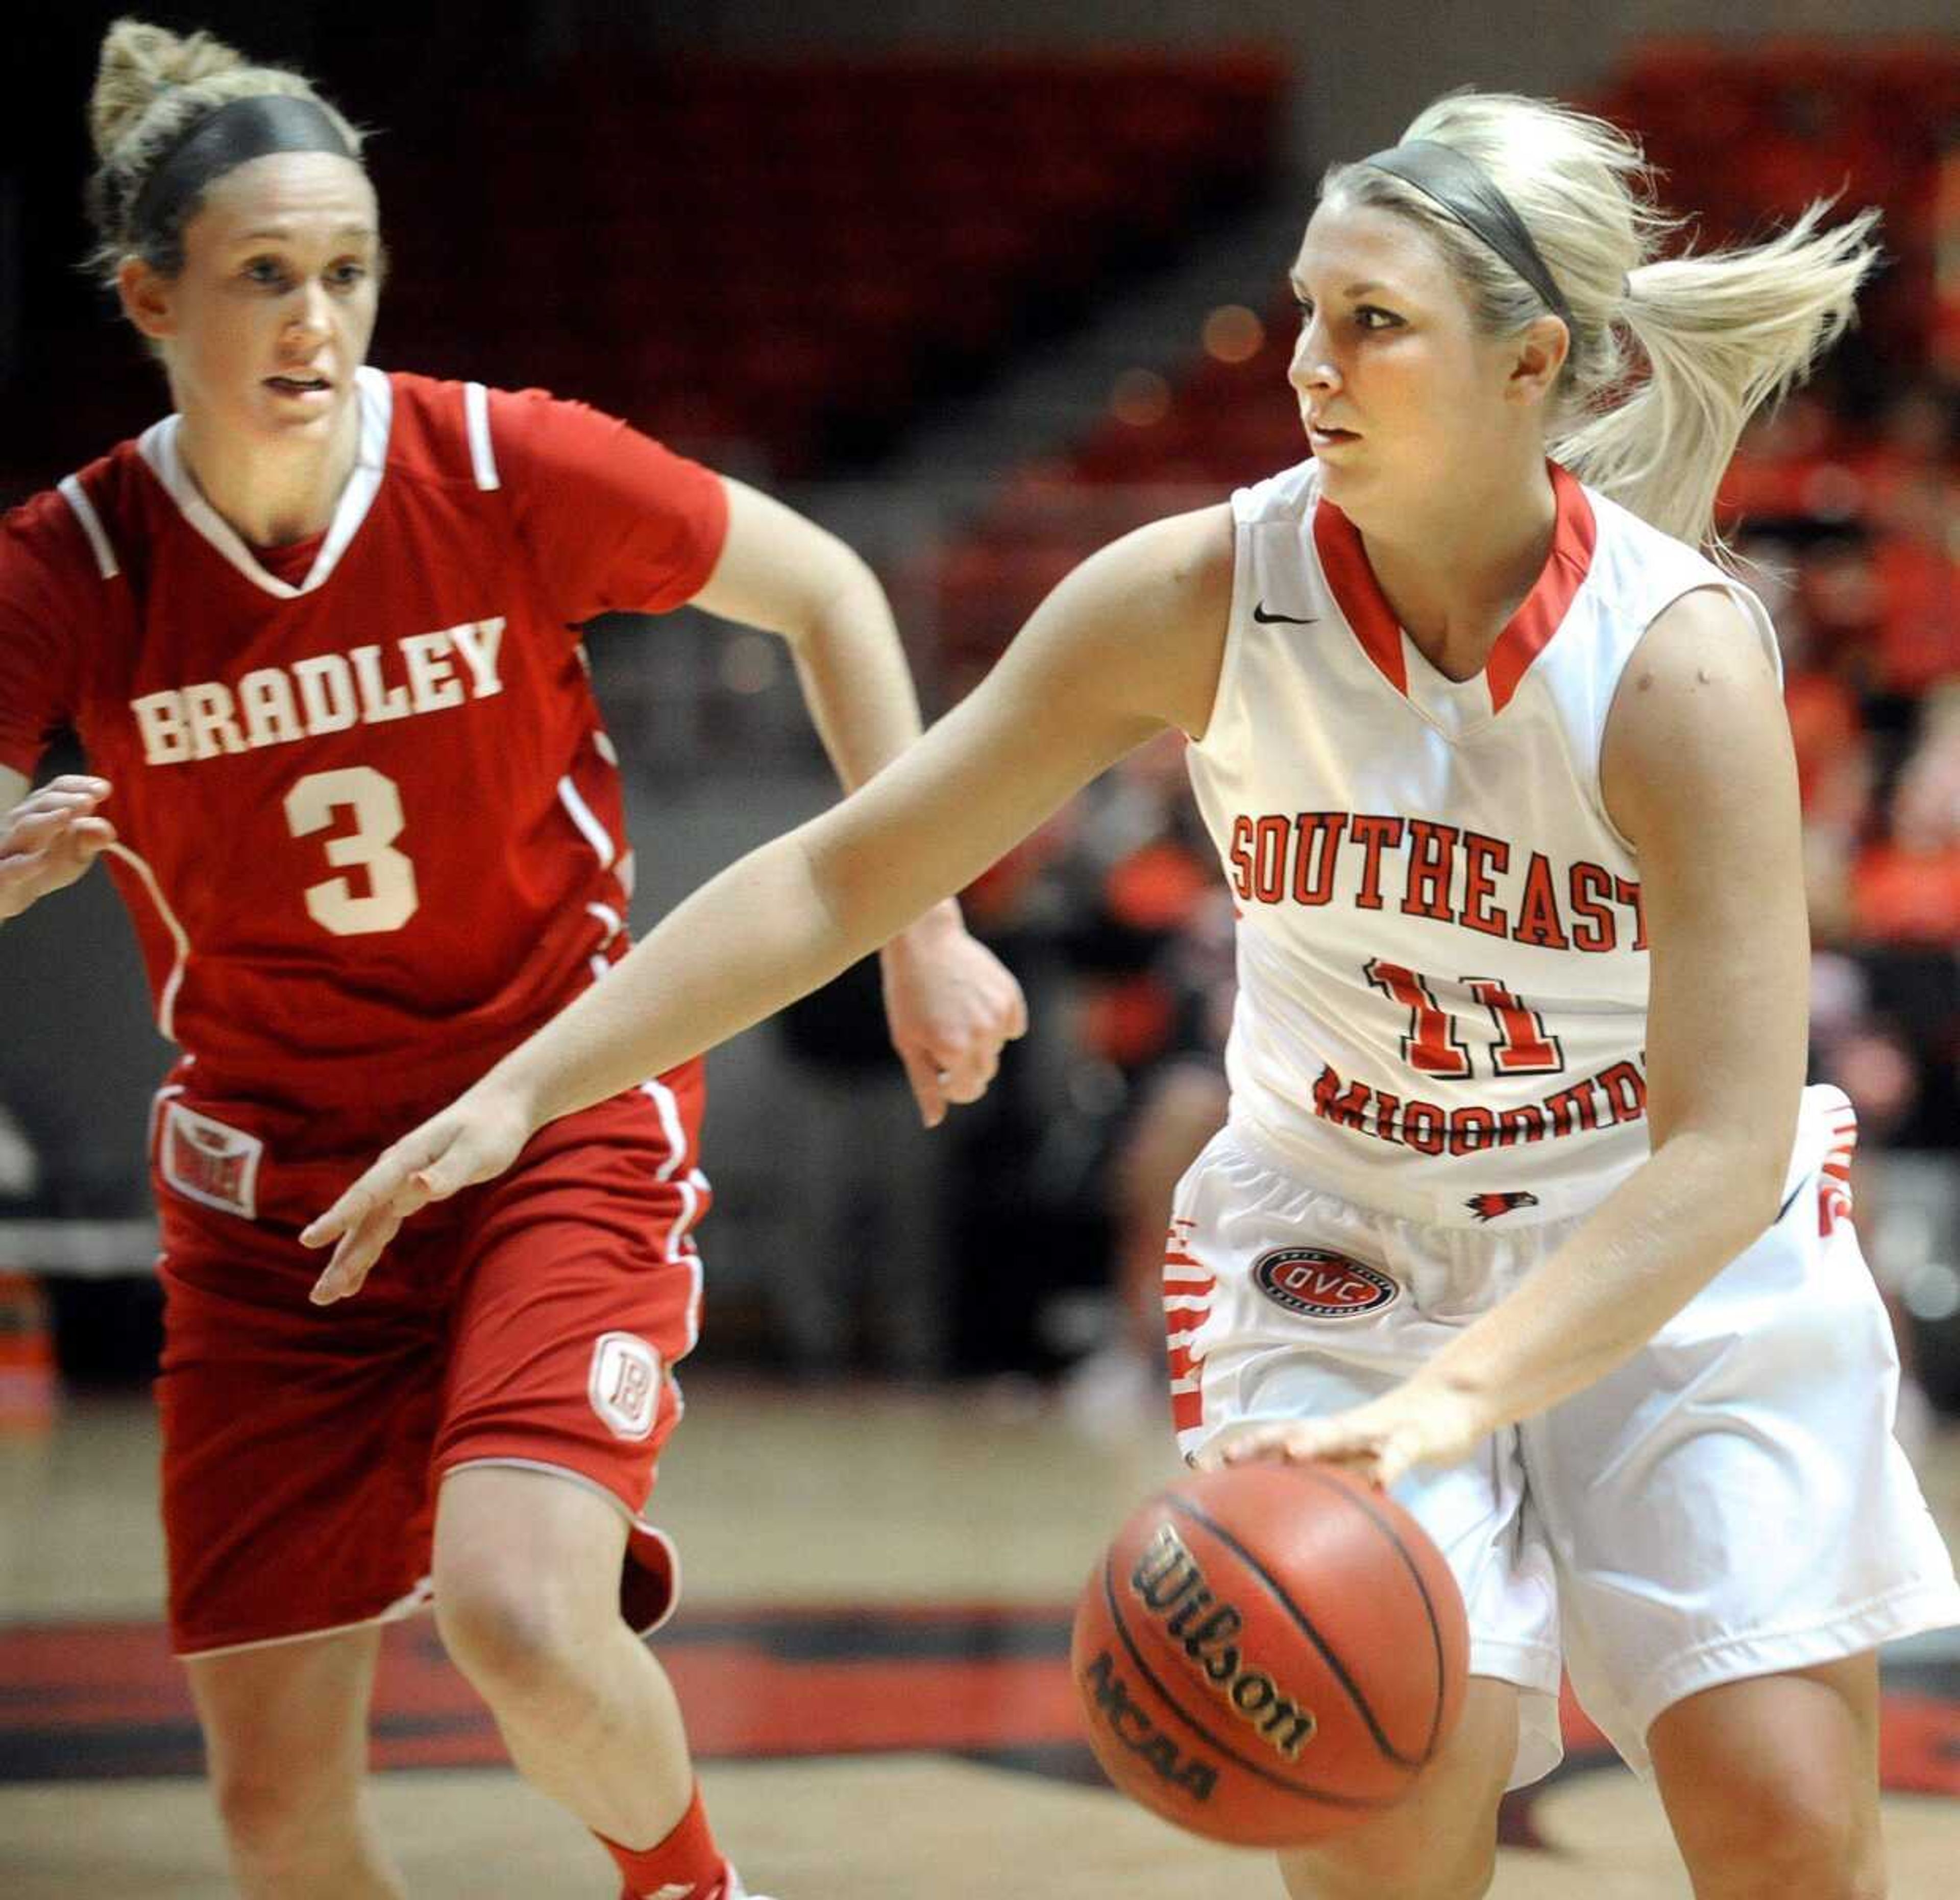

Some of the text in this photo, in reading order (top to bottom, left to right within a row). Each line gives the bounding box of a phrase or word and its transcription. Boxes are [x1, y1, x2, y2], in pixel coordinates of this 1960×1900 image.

[130, 617, 506, 765] BRADLEY
[284, 766, 419, 936] 3
[1229, 812, 1648, 953] SOUTHEAST
[1362, 957, 1564, 1080] 11
[1284, 1266, 1368, 1301] OVC
[1131, 1522, 1317, 1761] Wilson
[1089, 1650, 1218, 1800] NCAA
